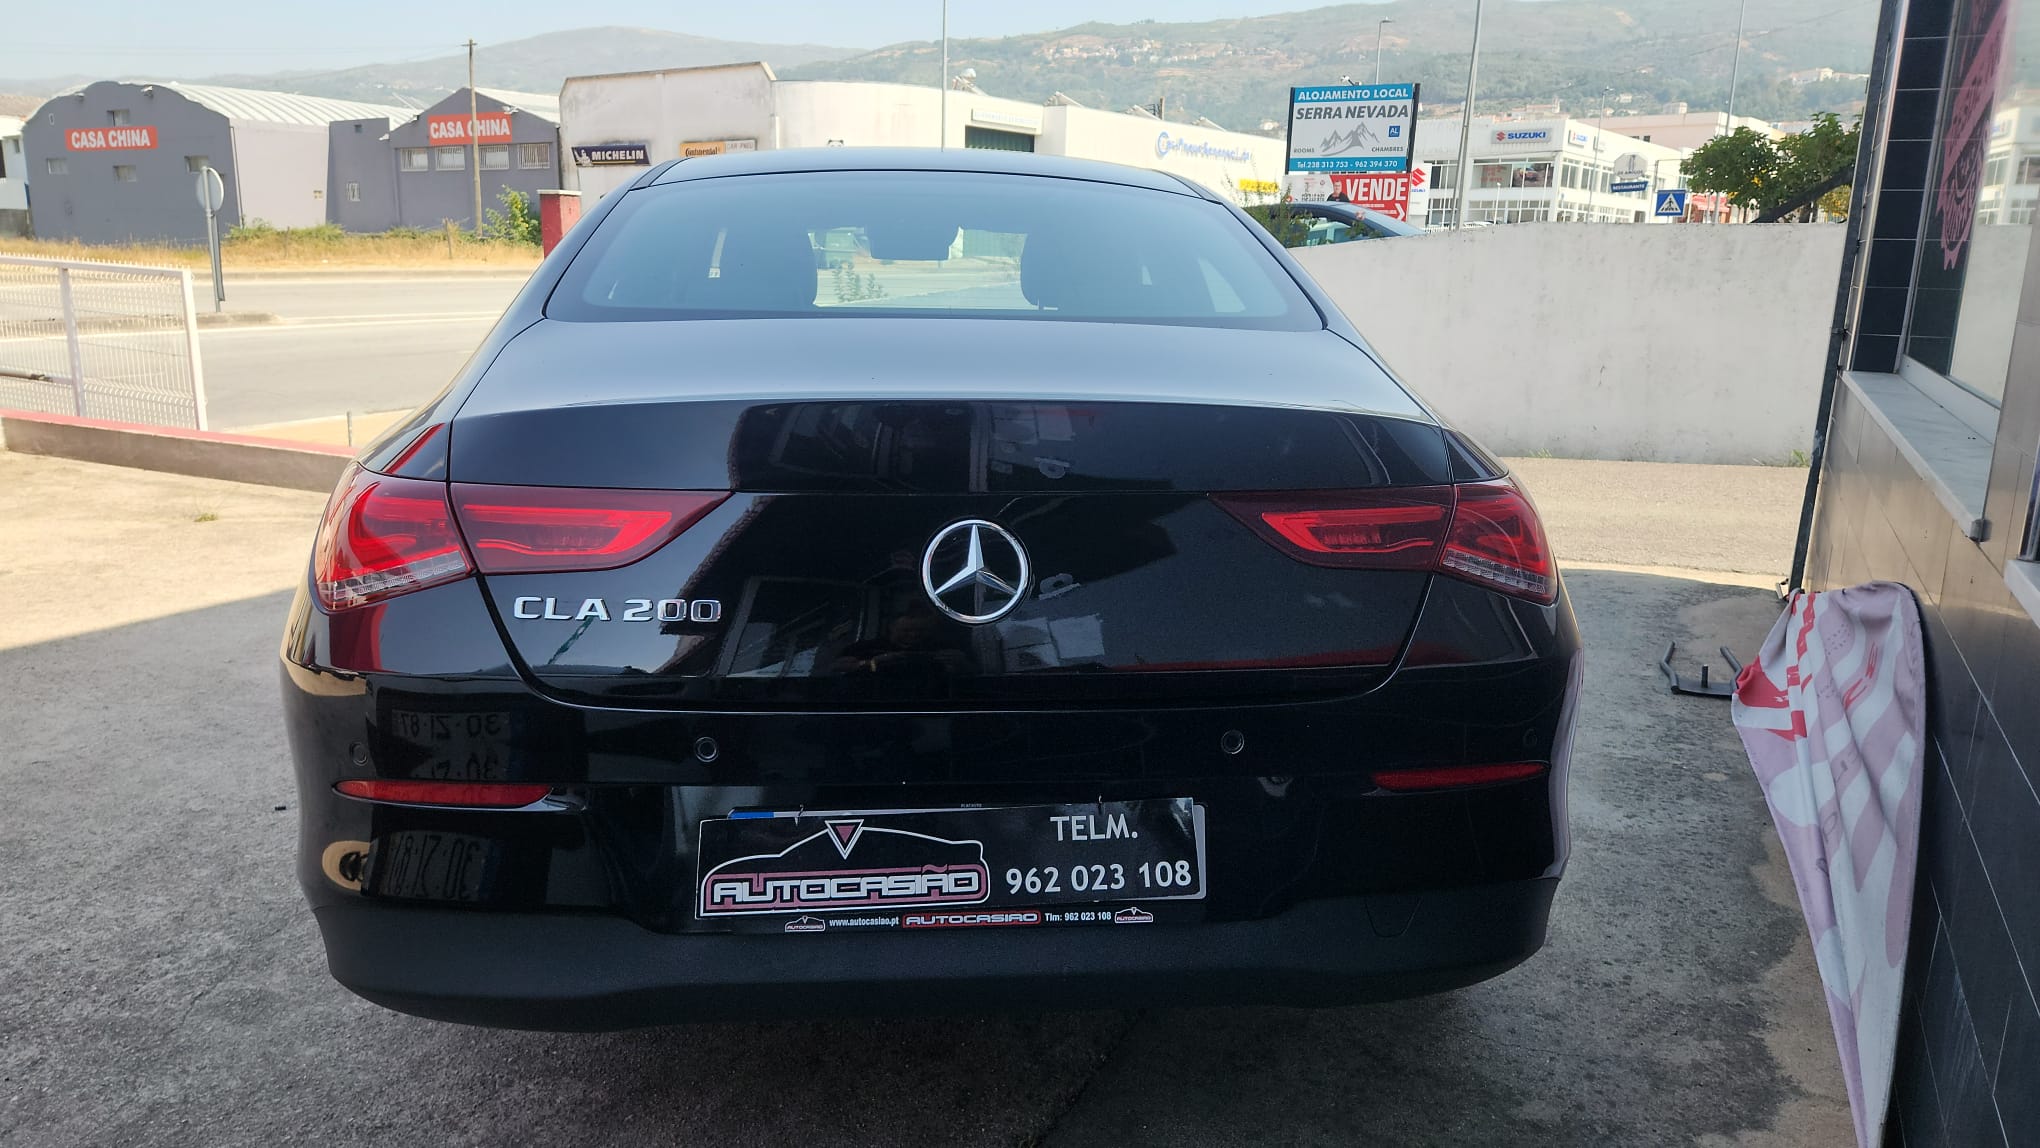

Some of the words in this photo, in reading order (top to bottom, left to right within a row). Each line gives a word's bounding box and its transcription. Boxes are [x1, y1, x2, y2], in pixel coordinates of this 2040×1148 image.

[1298, 89, 1371, 101] ALOJAMENTO
[1374, 88, 1409, 98] LOCAL
[1295, 106, 1344, 120] SERRA
[1345, 104, 1409, 119] NEVADA
[71, 131, 106, 149] CASA
[107, 129, 151, 147] CHINA
[430, 121, 465, 139] CASA
[1507, 131, 1546, 140] SUZUKI
[592, 149, 644, 161] MICHELIN
[1321, 161, 1335, 169] 313
[1384, 160, 1398, 168] 370
[1345, 178, 1408, 201] VENDE
[513, 596, 611, 621] CLA
[622, 598, 723, 622] 200
[1050, 813, 1139, 842] TELM.
[713, 863, 980, 903] AUTOCASIÃO
[1005, 867, 1062, 895] 962
[1070, 863, 1126, 891] 023
[1138, 860, 1192, 888] 108
[1064, 912, 1079, 921] 962
[1081, 912, 1096, 921] 023
[1098, 911, 1112, 920] 108
